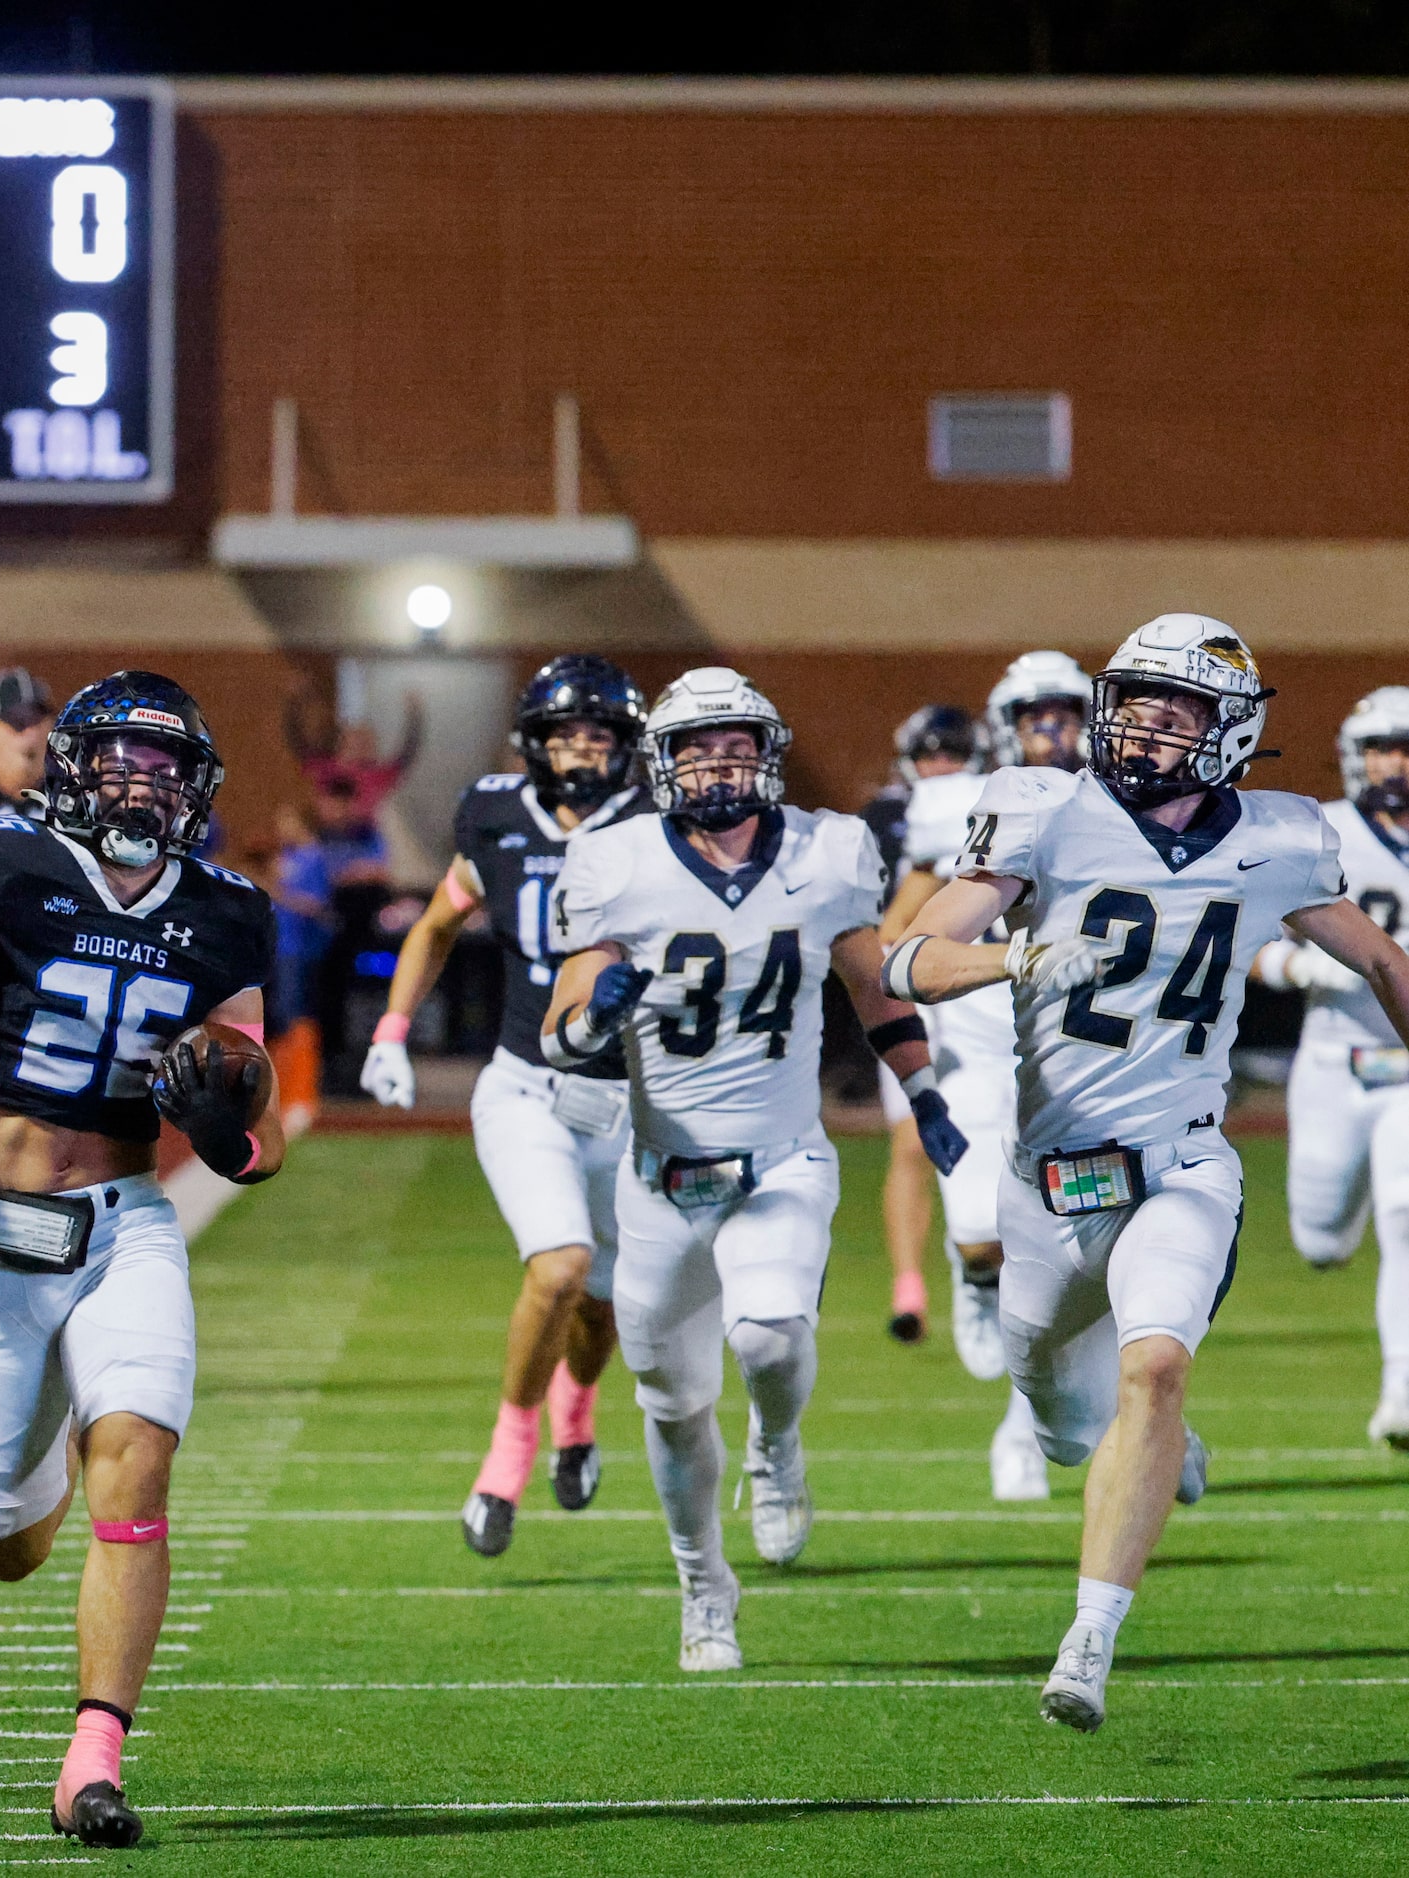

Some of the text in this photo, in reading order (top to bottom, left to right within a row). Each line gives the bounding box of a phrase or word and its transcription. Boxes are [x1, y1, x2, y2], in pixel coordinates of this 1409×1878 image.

[51, 164, 128, 283] 0
[48, 311, 109, 406] 3
[137, 710, 180, 726] Riddell
[73, 933, 169, 969] BOBCATS
[656, 926, 804, 1063] 34
[1057, 882, 1245, 1060] 24
[14, 956, 194, 1100] 26
